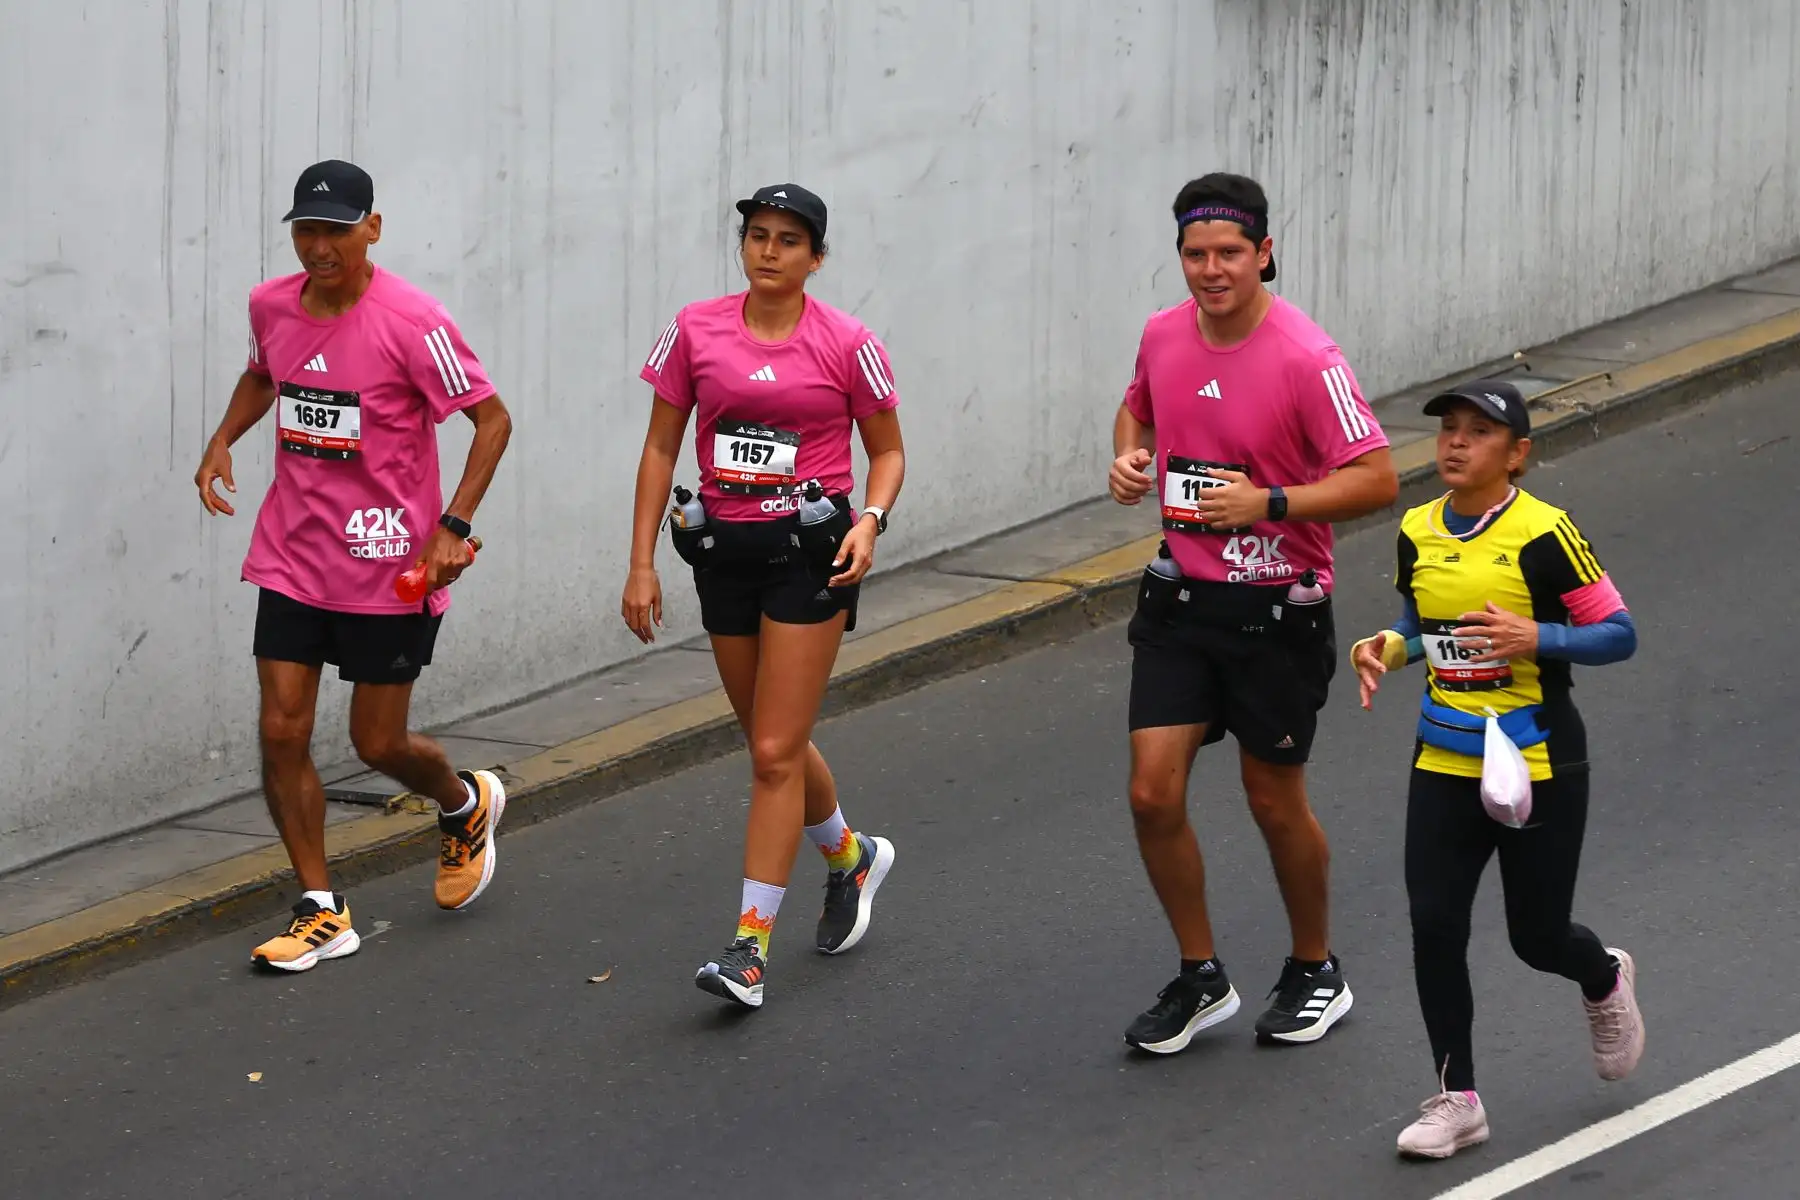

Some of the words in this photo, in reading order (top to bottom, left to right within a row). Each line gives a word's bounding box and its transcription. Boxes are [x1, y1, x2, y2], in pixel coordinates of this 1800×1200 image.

[294, 404, 341, 429] 1687
[307, 435, 323, 445] 42K
[730, 441, 775, 466] 1157
[739, 473, 757, 482] 42K
[1181, 479, 1226, 501] 11
[760, 494, 805, 513] adicl
[345, 507, 410, 539] 42K
[349, 539, 411, 559] adiclub
[1222, 534, 1288, 566] 42K
[1227, 563, 1293, 583] adiclub
